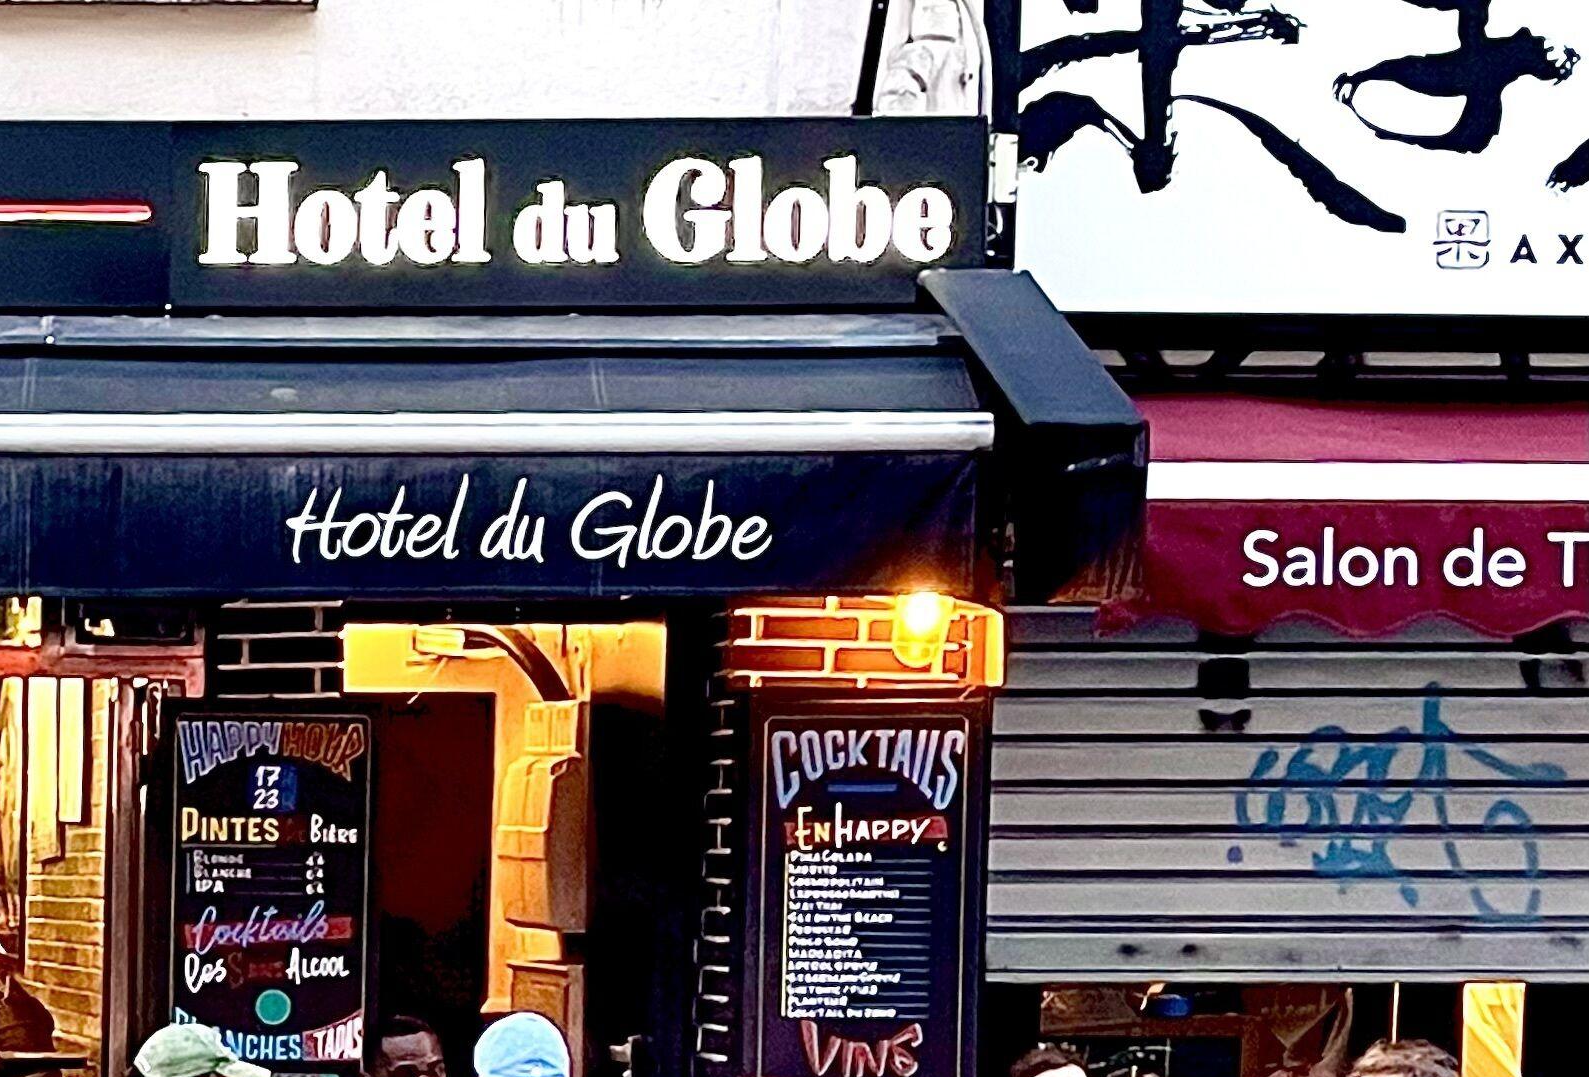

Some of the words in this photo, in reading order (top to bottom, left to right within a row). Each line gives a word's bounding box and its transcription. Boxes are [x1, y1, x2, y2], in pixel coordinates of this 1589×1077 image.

[197, 155, 492, 266] Hotel
[512, 179, 619, 264] du
[642, 153, 954, 264] Globe
[286, 473, 469, 565] Hotel
[479, 474, 545, 563] du
[570, 474, 773, 568] Globe
[1241, 526, 1418, 588] Salon
[1442, 527, 1526, 587] de
[178, 720, 283, 784] HAPPY
[282, 721, 365, 782] HOUR
[255, 765, 282, 787] 17
[771, 729, 966, 811] COCKTAILS
[181, 806, 280, 842] PINTES
[252, 788, 280, 810] 23
[834, 801, 932, 849] HAPPY
[191, 900, 330, 955] Cocktails
